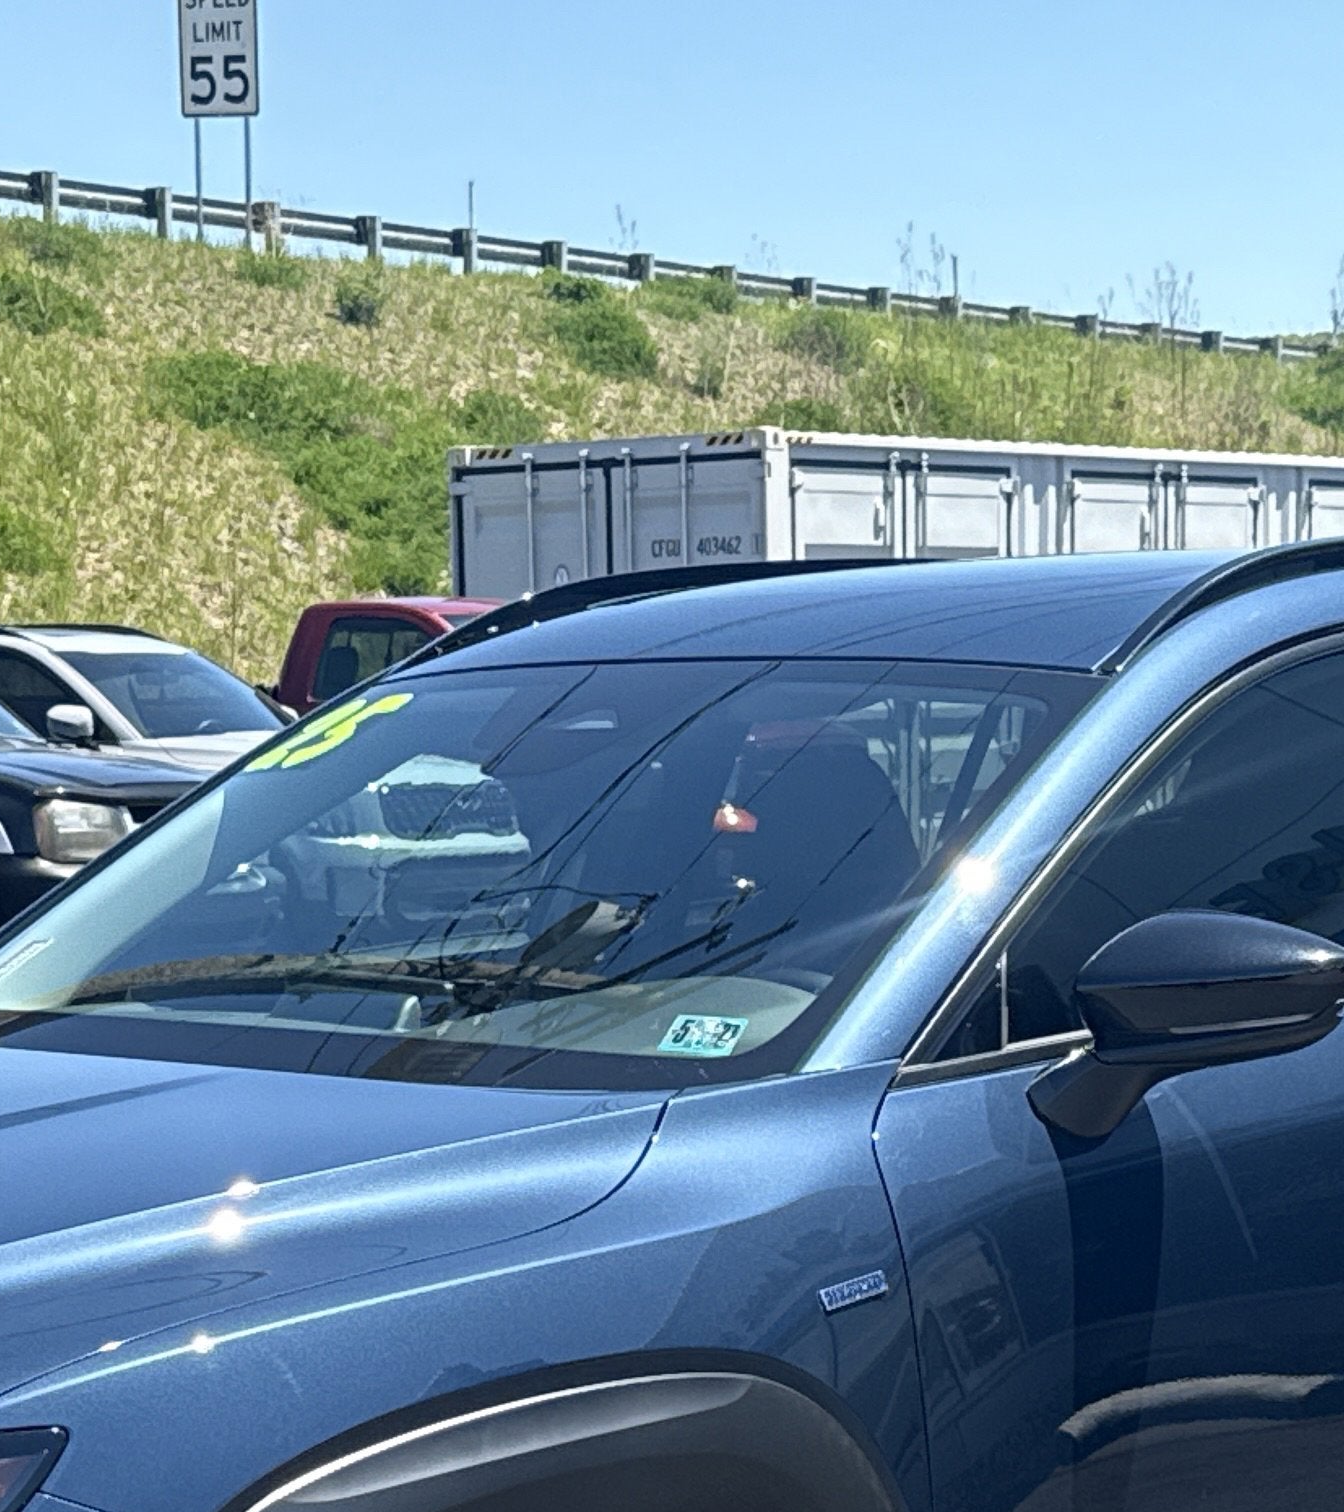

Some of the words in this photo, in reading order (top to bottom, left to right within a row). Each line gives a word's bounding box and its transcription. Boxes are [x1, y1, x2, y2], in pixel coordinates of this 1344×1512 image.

[192, 21, 243, 43] LIMIT
[190, 54, 250, 105] 55
[672, 1020, 696, 1043] 5
